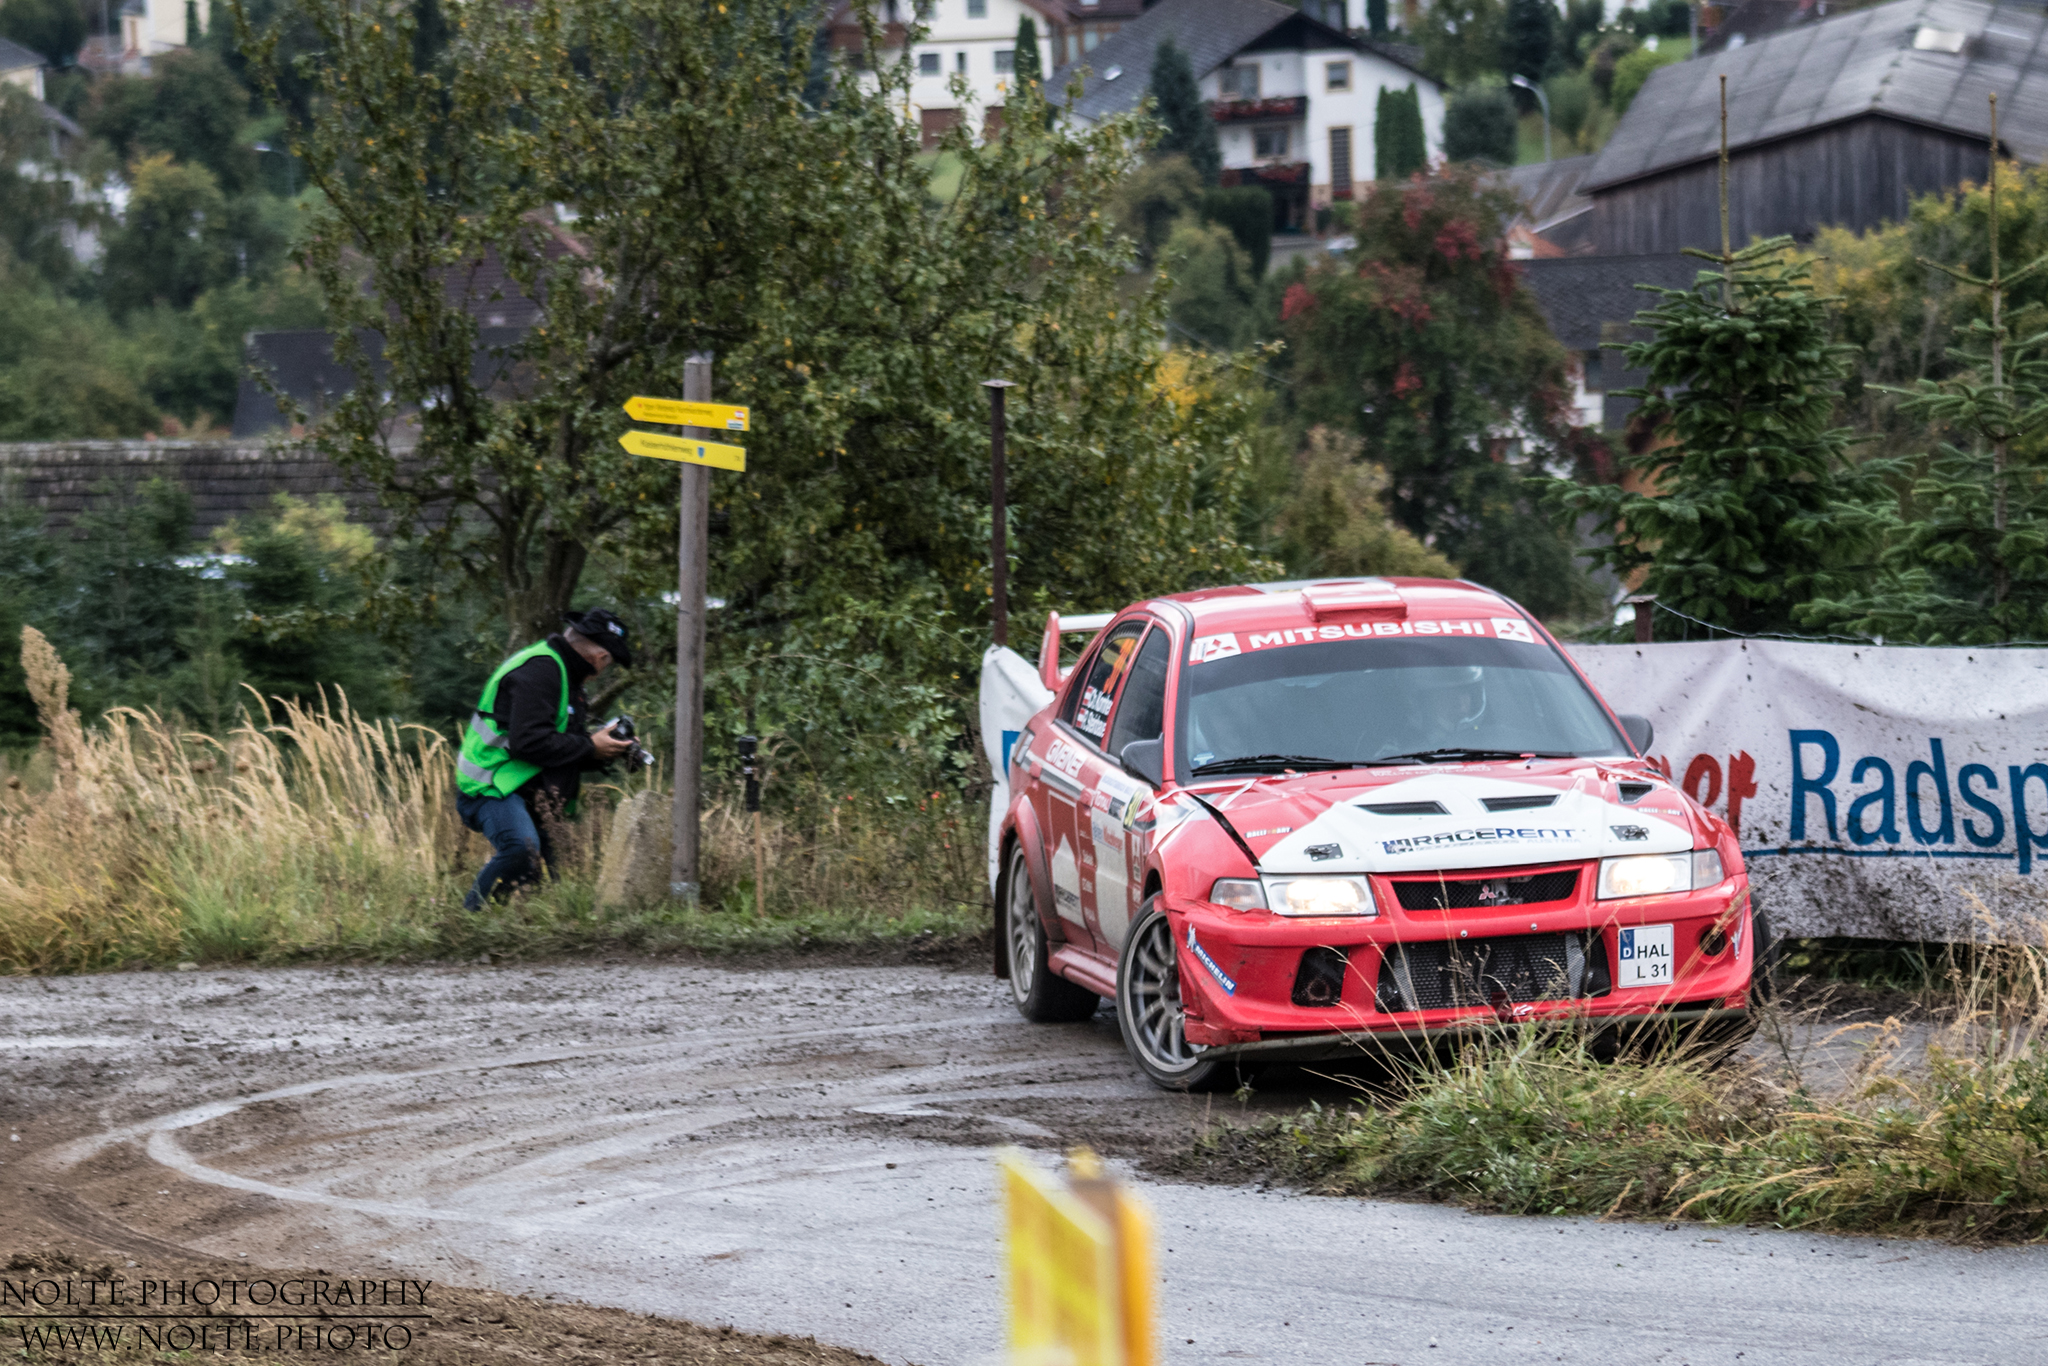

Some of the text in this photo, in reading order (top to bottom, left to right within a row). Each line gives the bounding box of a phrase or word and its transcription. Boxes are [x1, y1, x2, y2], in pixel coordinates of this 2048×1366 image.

[1249, 620, 1486, 649] MITSUBISHI
[1411, 827, 1577, 847] RACERENT
[1622, 943, 1669, 959] D HAL
[1195, 945, 1235, 991] MICHELIN
[1637, 963, 1667, 979] L 31
